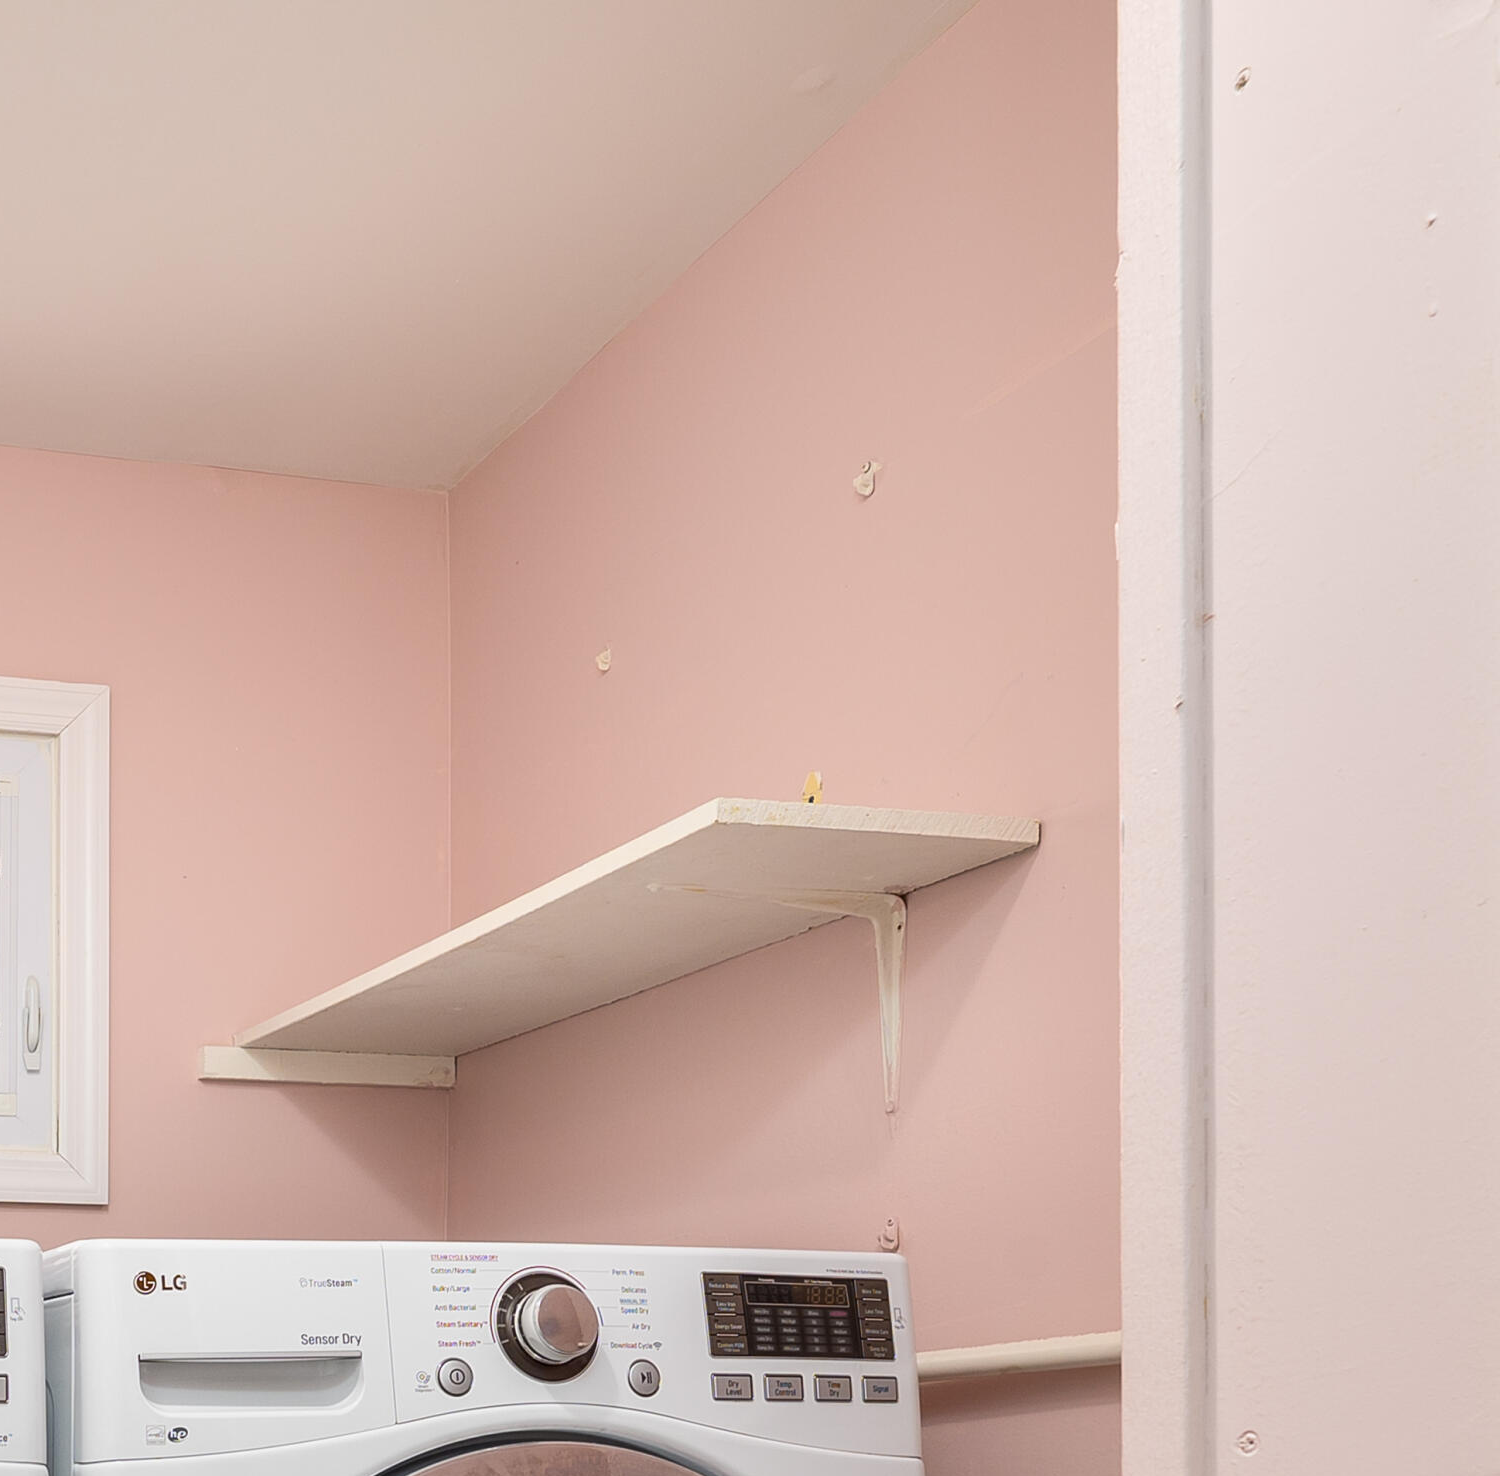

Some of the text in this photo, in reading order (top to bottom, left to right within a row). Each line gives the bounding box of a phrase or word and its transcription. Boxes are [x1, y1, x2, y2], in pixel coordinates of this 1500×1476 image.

[161, 1274, 187, 1291] LG
[301, 1333, 362, 1346] Sensor Dry
[437, 1340, 458, 1348] Steam
[638, 1342, 653, 1350] Cycle
[728, 1380, 739, 1389] Dry
[827, 1380, 841, 1388] Time
[726, 1388, 743, 1396] Level
[775, 1388, 797, 1397] Control
[829, 1389, 840, 1398] Dry
[872, 1385, 890, 1395] Signal
